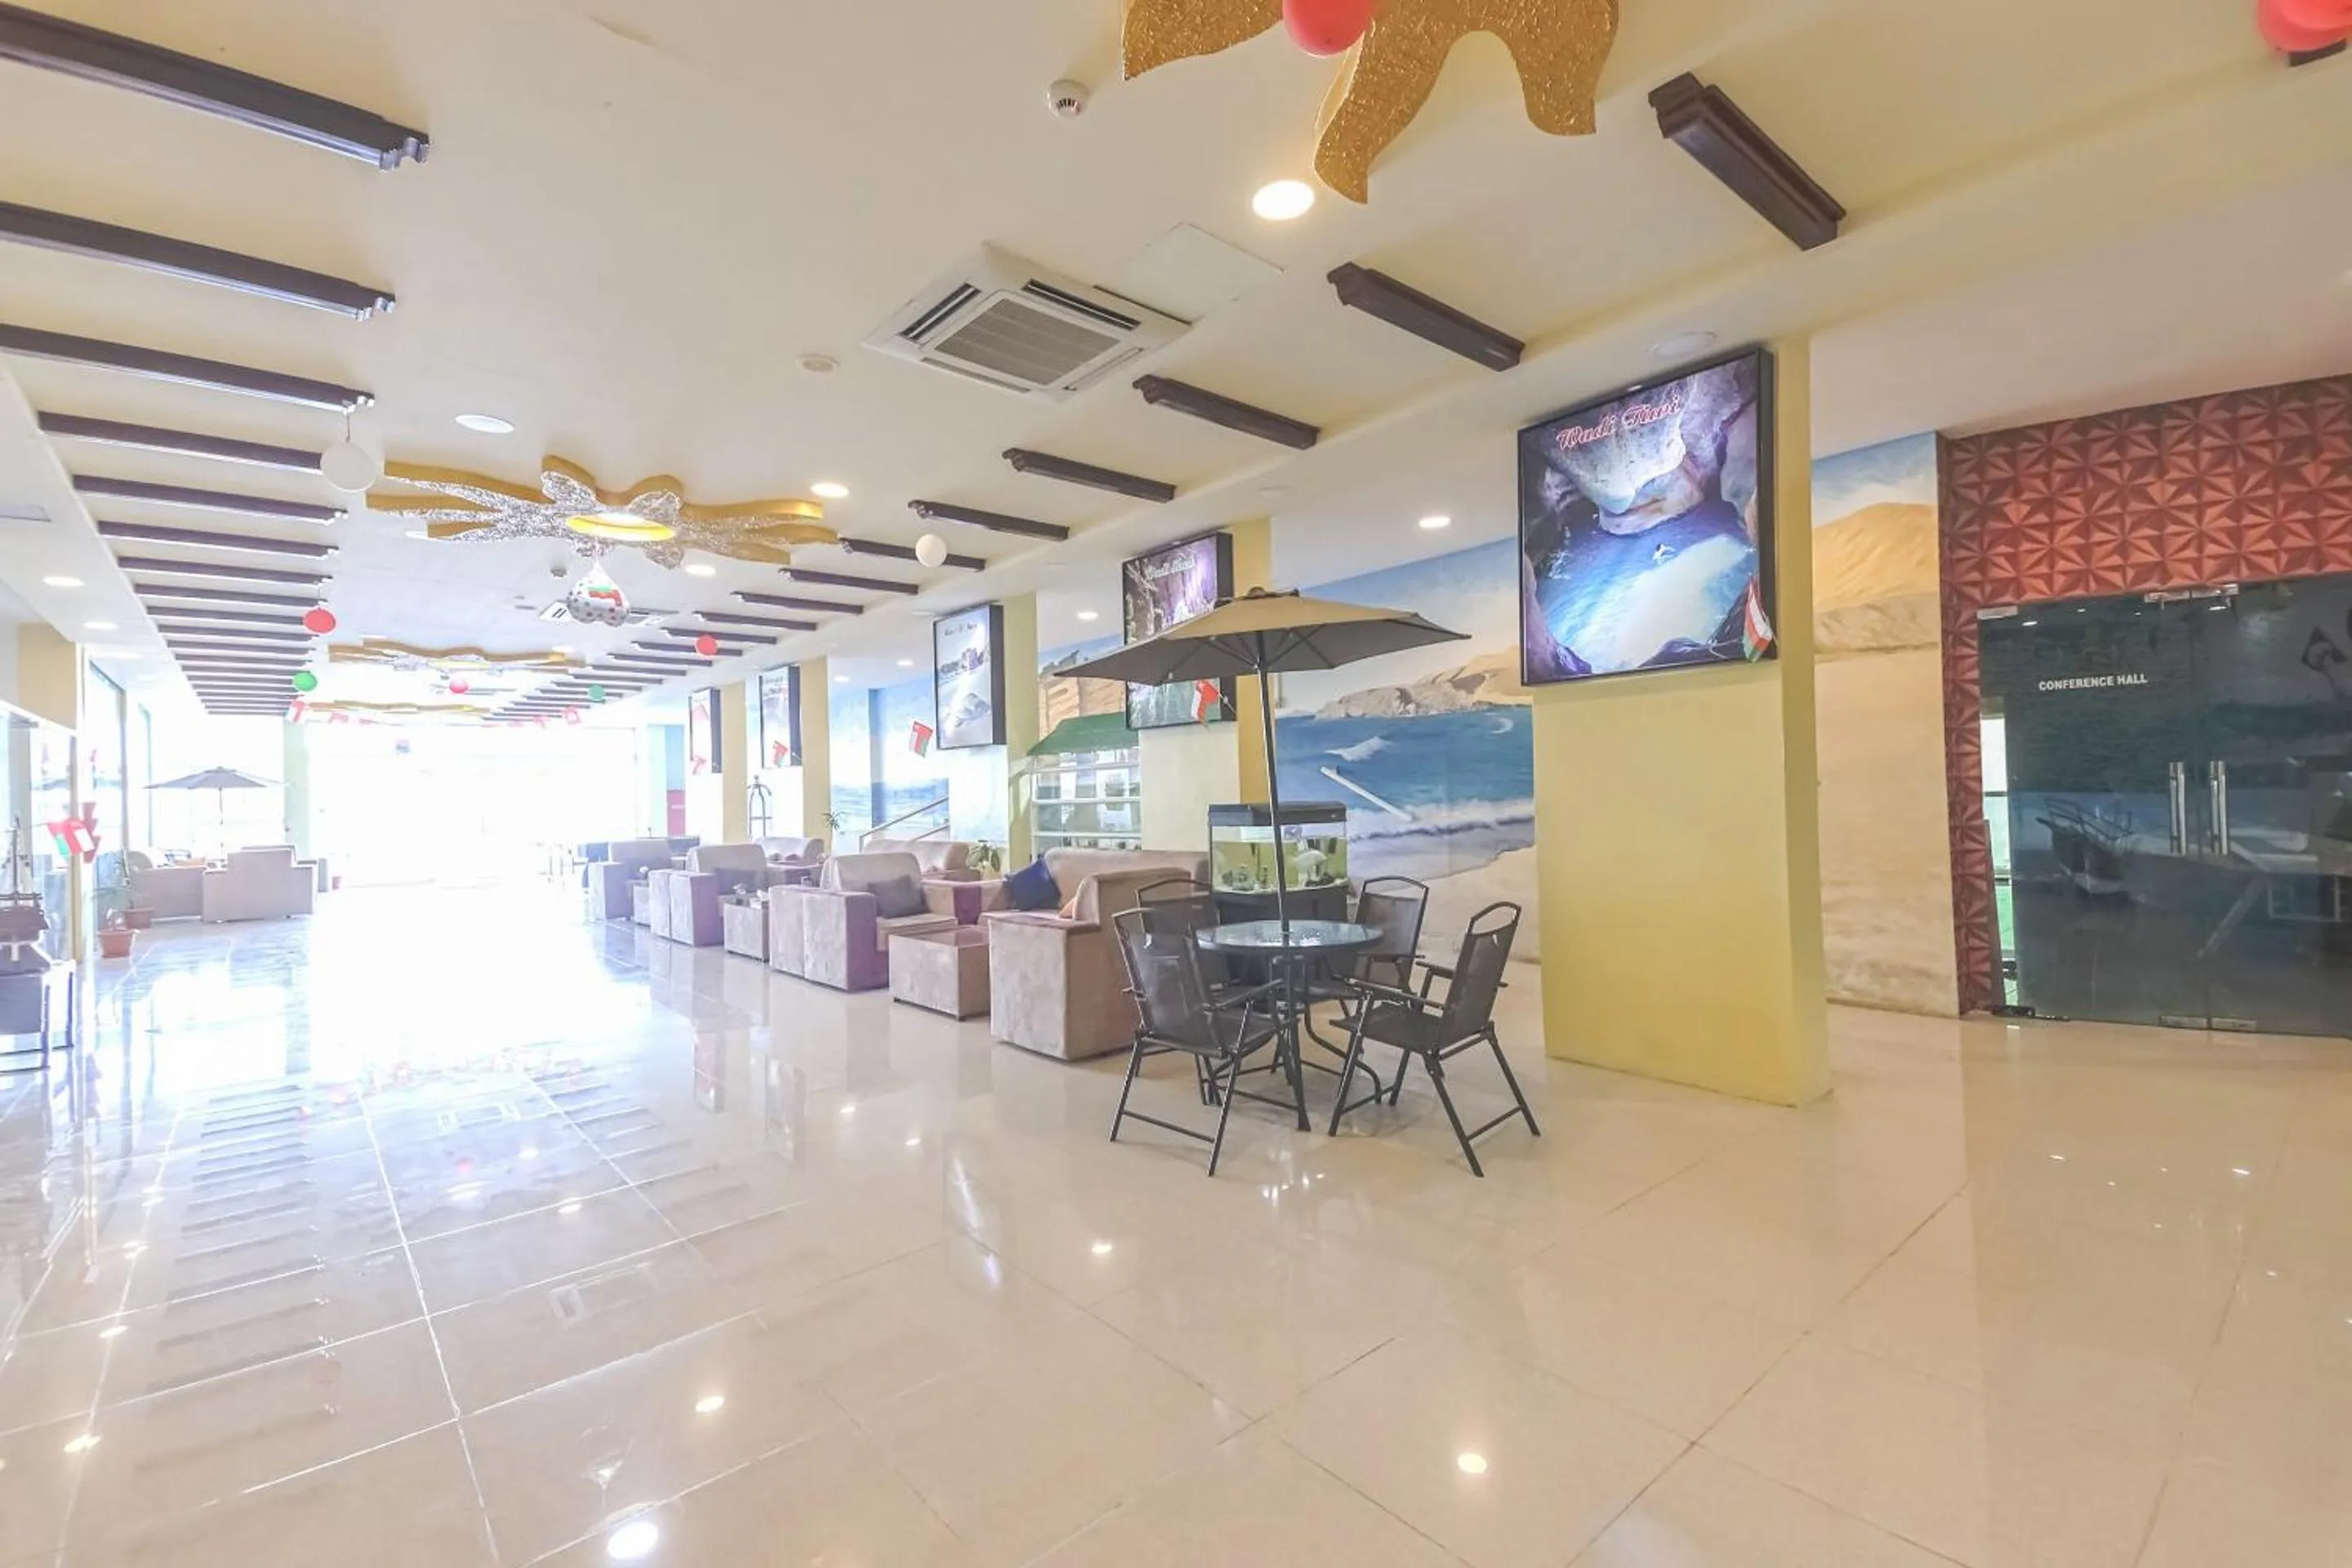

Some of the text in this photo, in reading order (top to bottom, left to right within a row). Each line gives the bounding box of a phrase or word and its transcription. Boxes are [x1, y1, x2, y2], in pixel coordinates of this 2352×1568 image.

[1556, 414, 1617, 450] Wadi
[2038, 673, 2149, 691] CONFERENCE HALL
